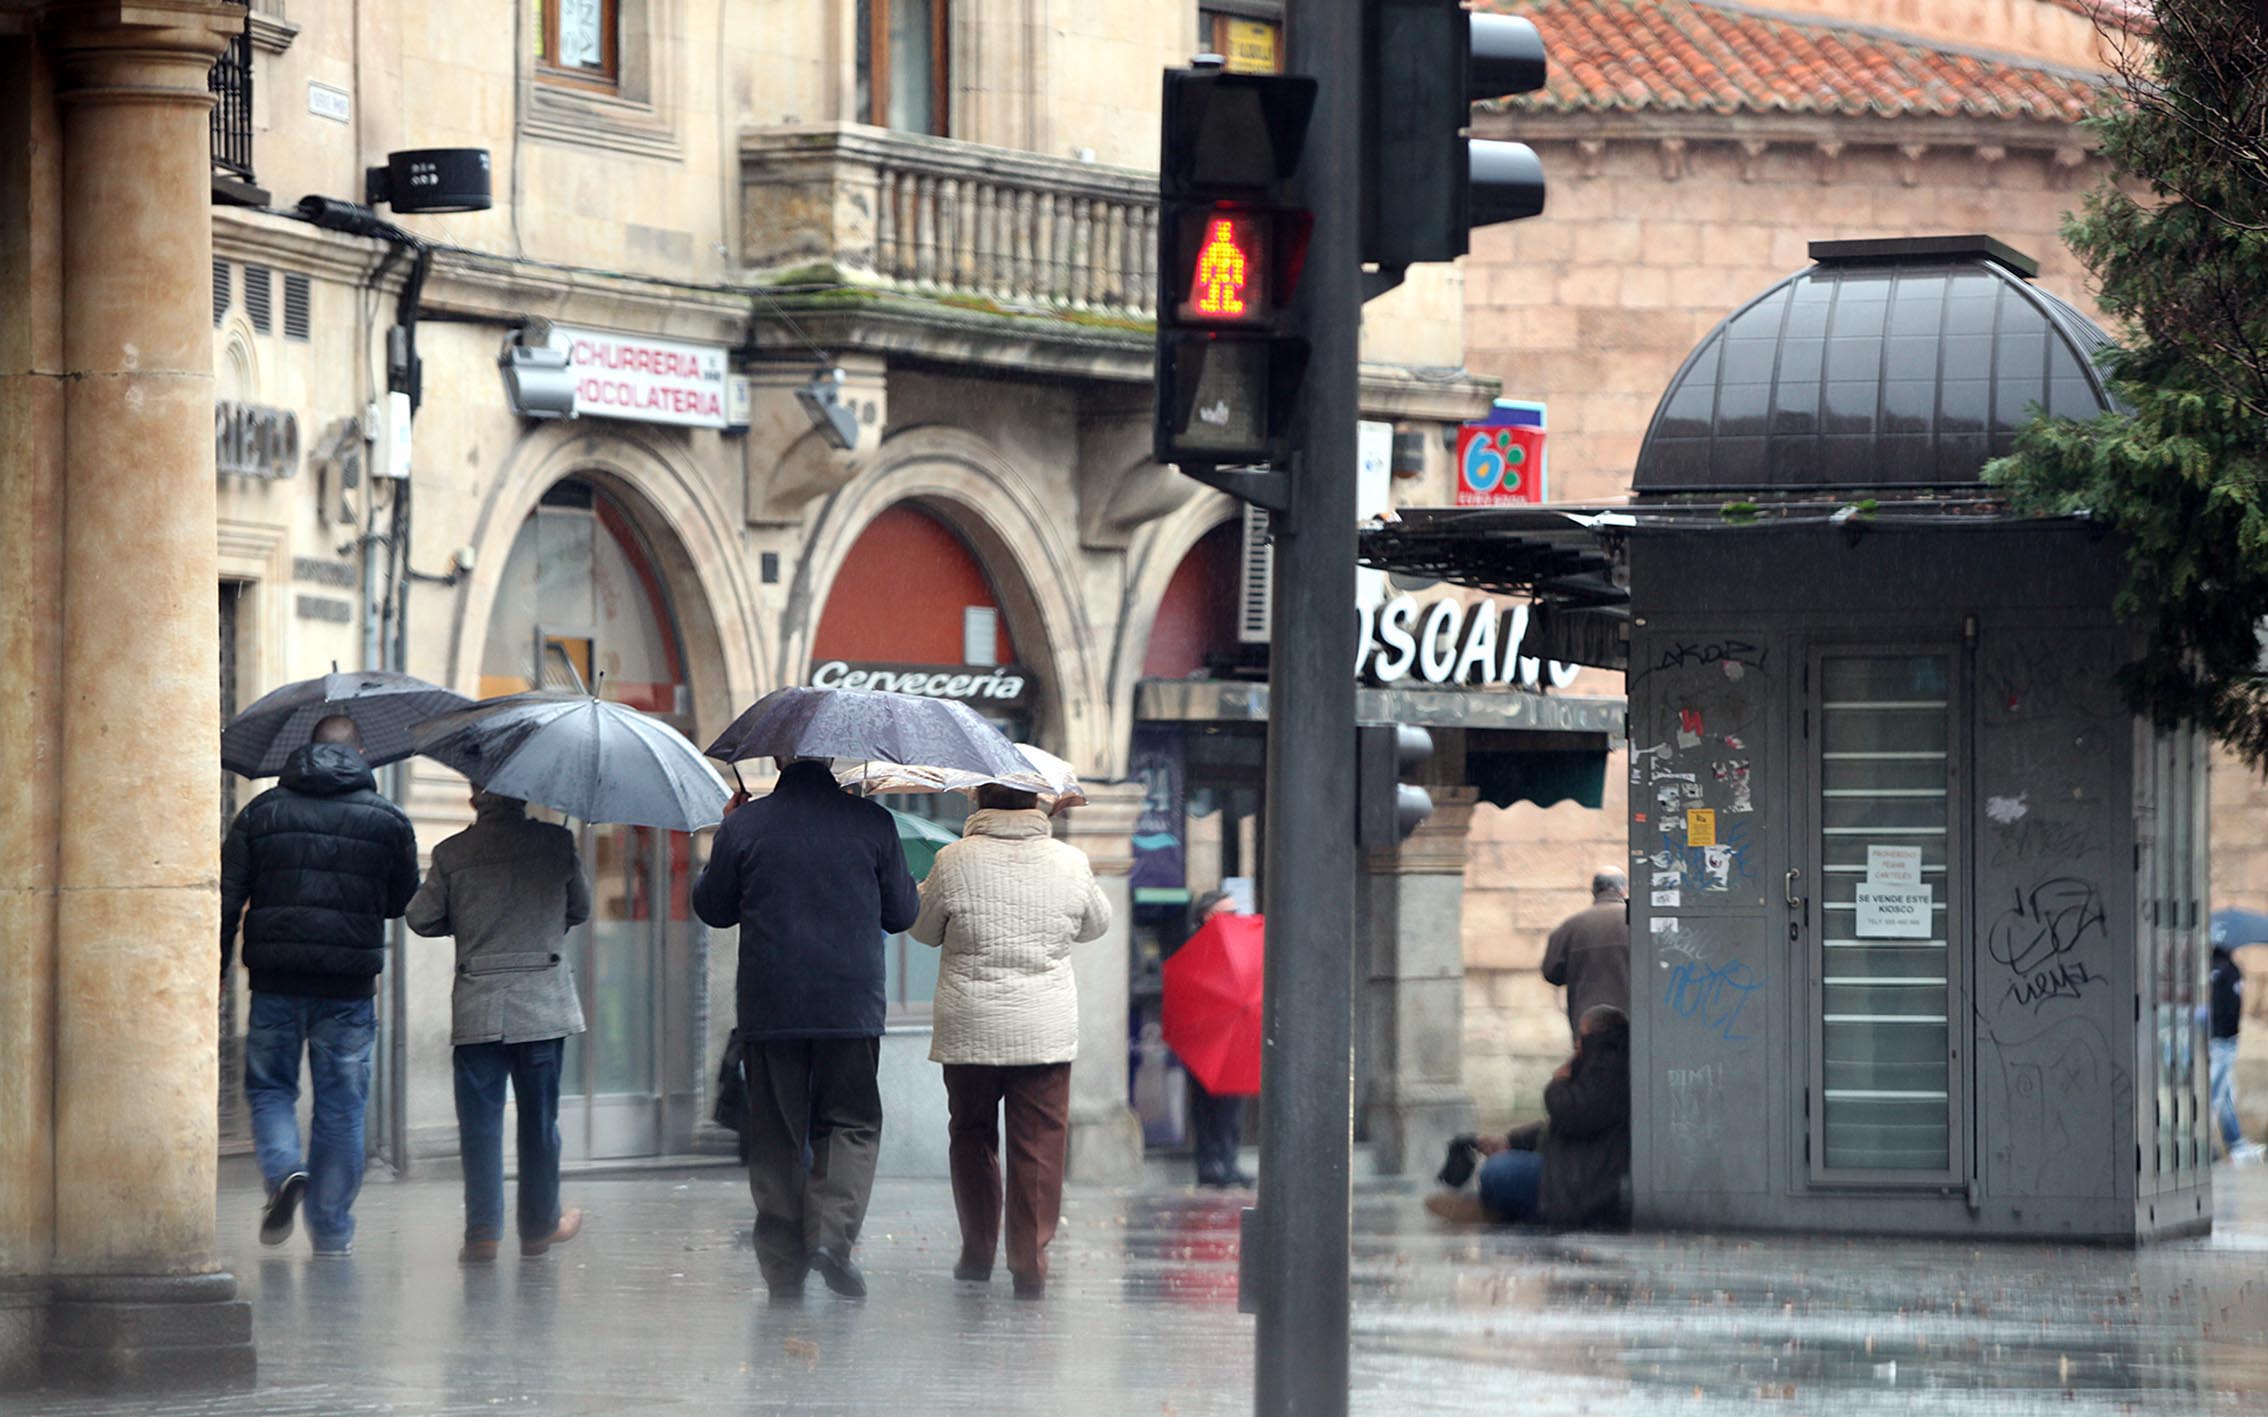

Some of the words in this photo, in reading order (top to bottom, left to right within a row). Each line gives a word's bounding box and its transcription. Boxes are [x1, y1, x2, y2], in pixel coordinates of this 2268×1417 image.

[574, 339, 700, 378] CHURRERIA
[1858, 894, 1870, 903] SE
[1872, 895, 1903, 904] VENDE
[1906, 895, 1929, 904] ESTE
[1878, 905, 1915, 913] KIOSCO
